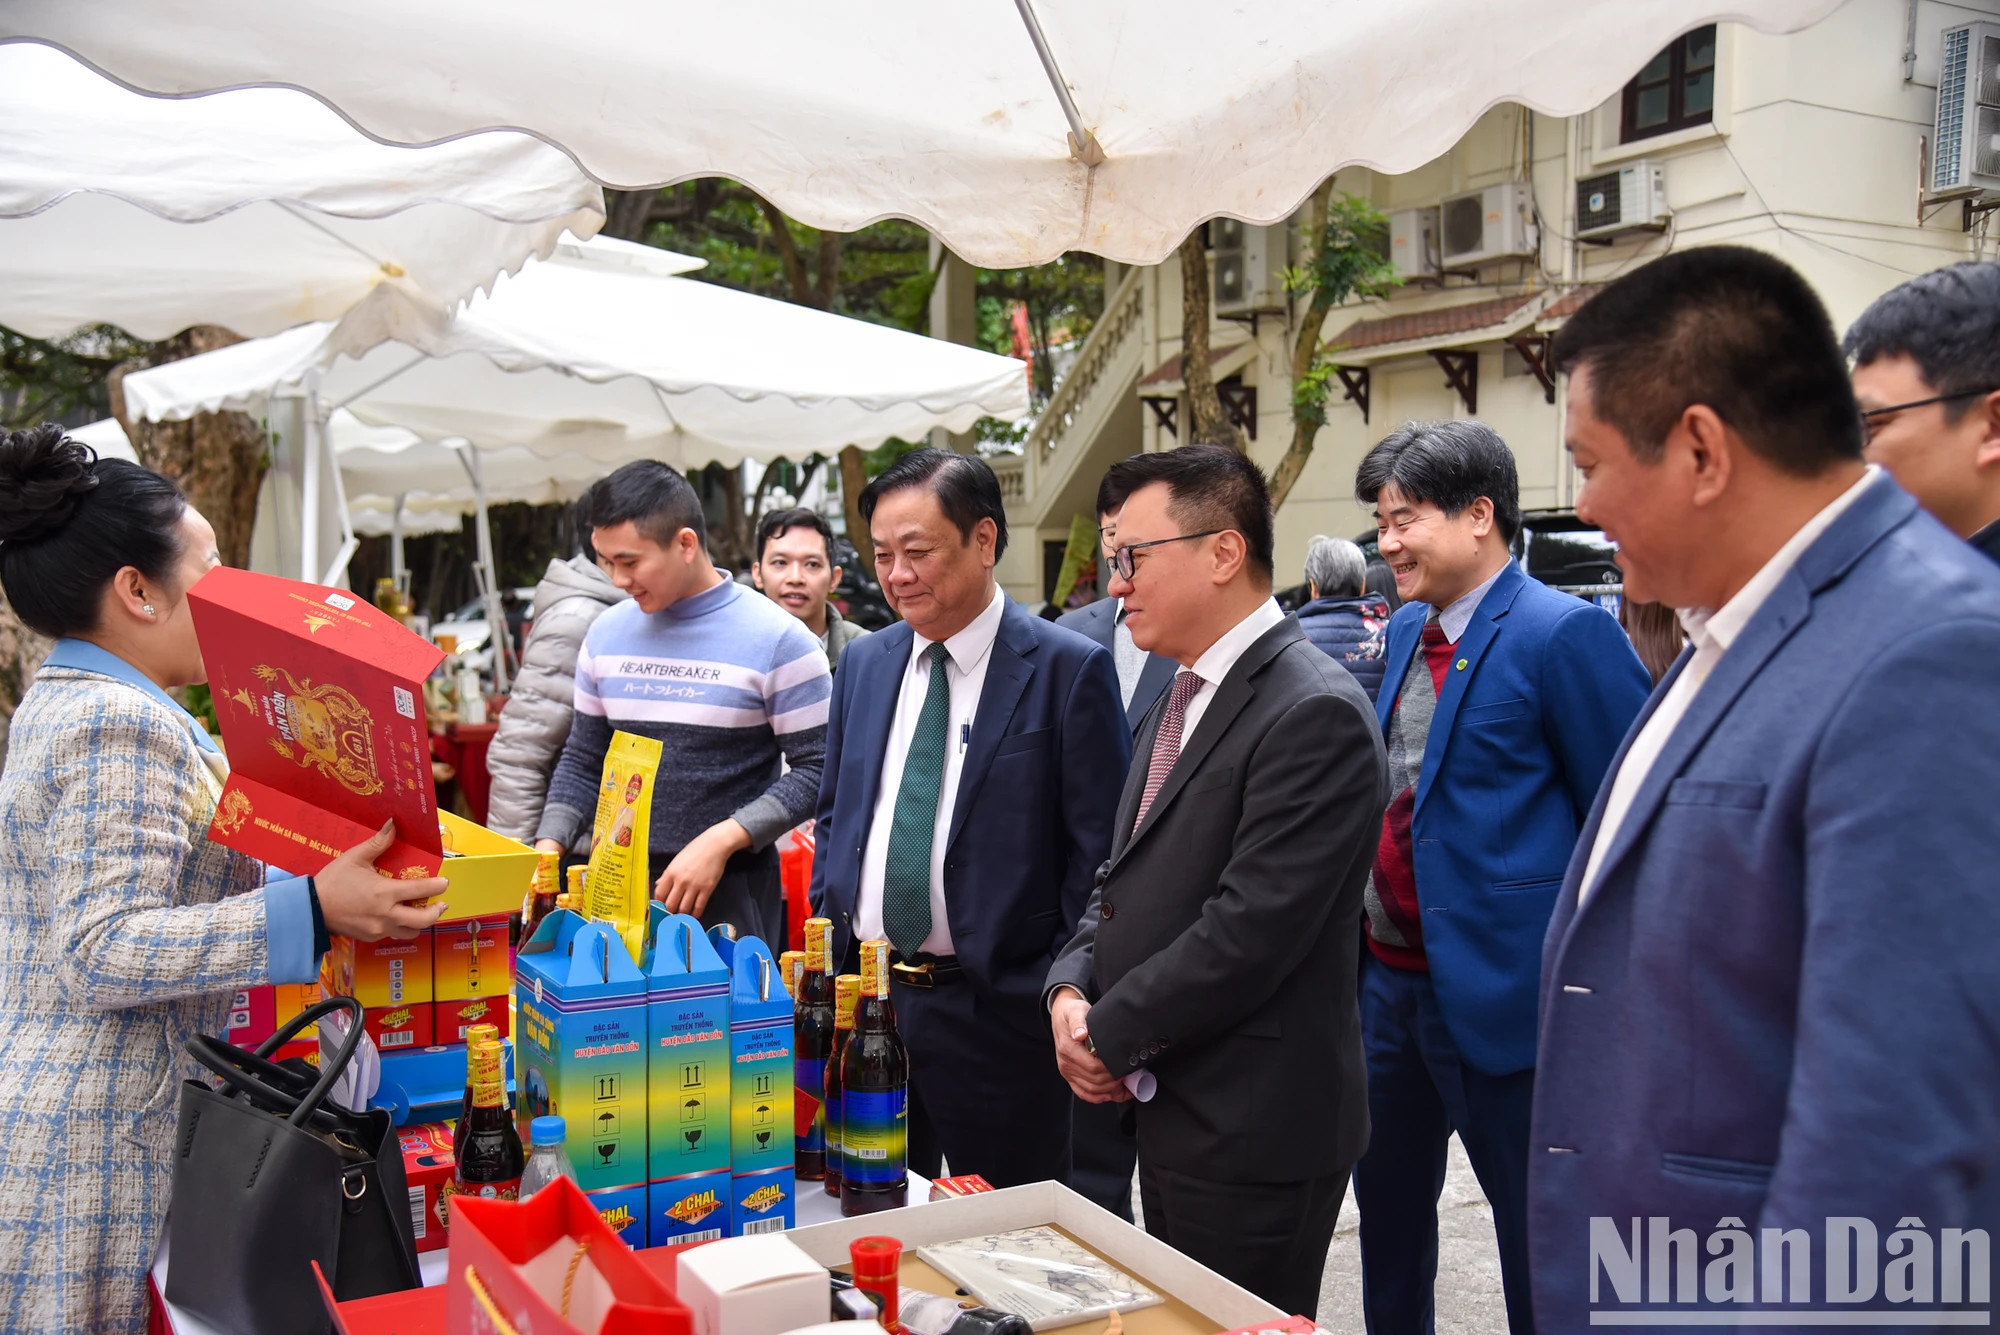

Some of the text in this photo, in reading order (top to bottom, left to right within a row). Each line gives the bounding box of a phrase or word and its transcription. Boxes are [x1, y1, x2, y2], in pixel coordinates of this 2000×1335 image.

[619, 661, 720, 680] HEARTBREAKER
[269, 690, 294, 741] VÂN ĐỒN
[469, 1001, 487, 1013] CHAI
[696, 1031, 708, 1042] VÂN
[575, 1045, 596, 1058] HUYỆN
[612, 1042, 625, 1053] VÂN
[674, 1189, 714, 1215] 2 CHAI
[748, 1183, 780, 1205] 2 CHAI
